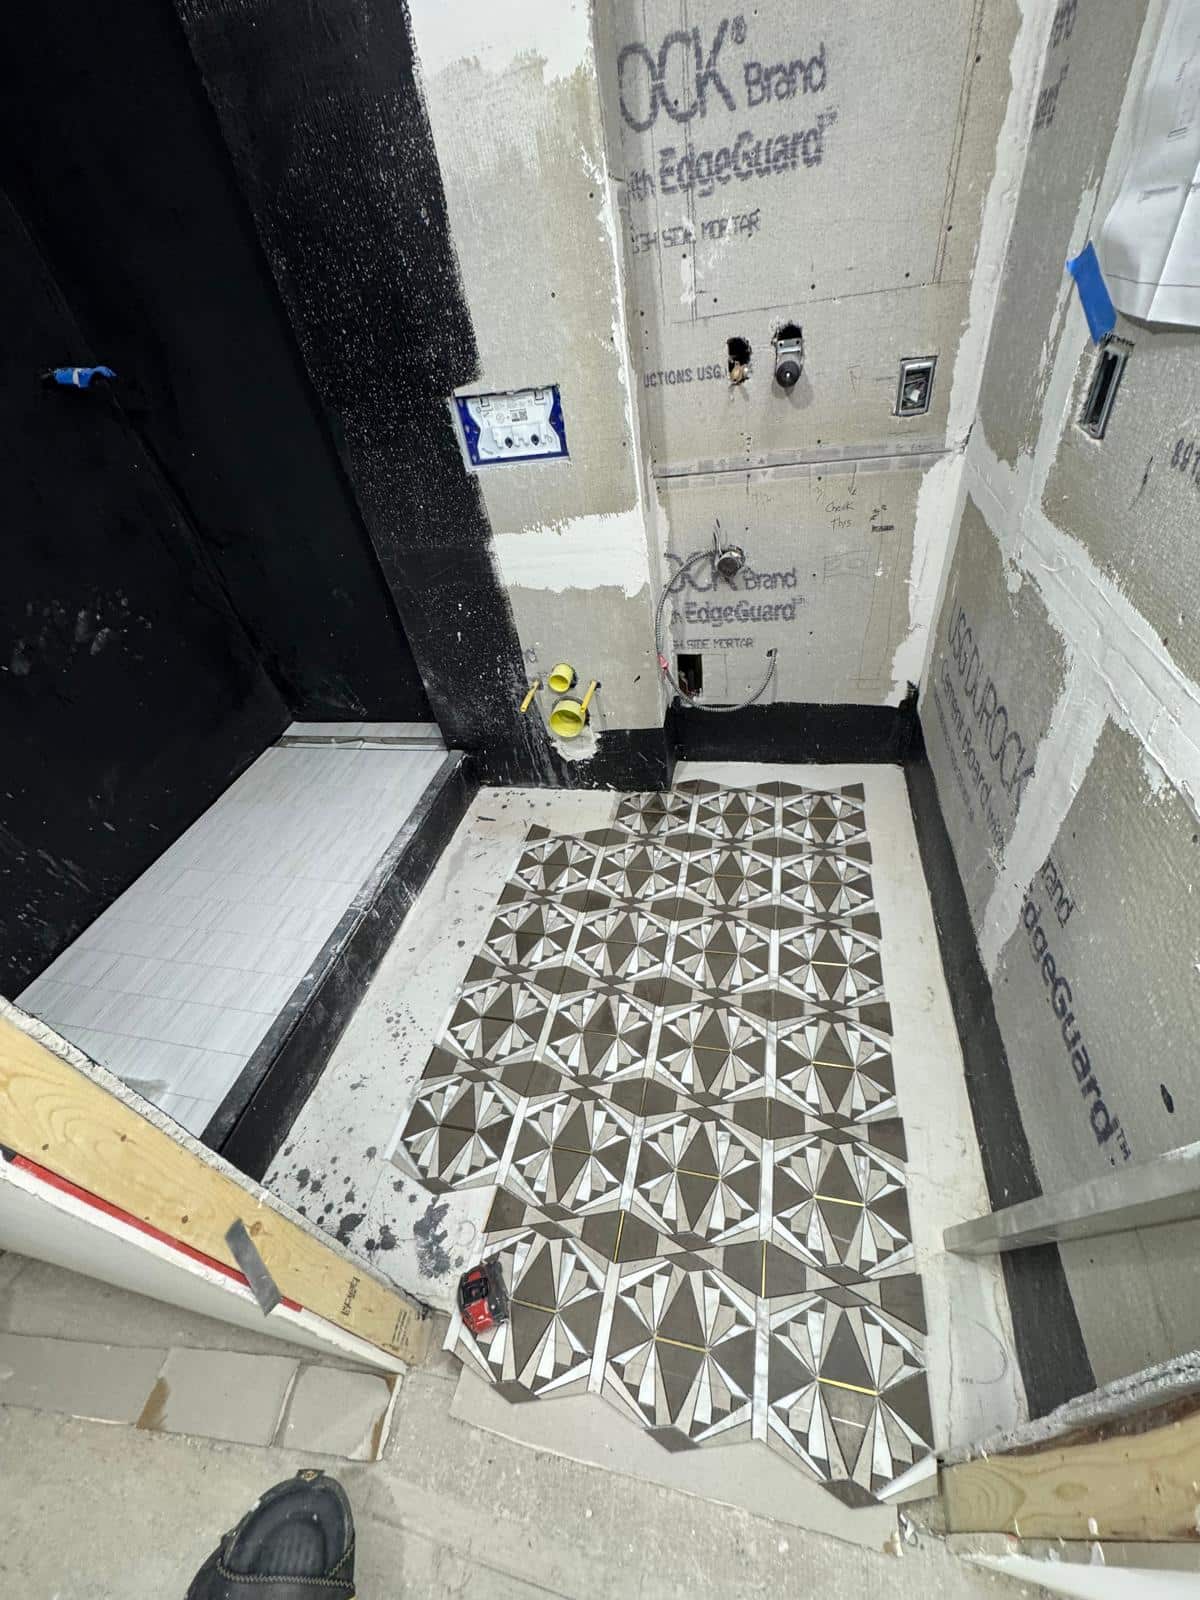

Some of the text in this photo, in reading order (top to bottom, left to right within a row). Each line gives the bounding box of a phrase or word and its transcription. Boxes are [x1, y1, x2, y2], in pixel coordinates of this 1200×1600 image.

[743, 41, 827, 107] Brand
[643, 368, 693, 388] UCTIONS
[744, 567, 797, 591] Brand
[961, 727, 992, 811] Board
